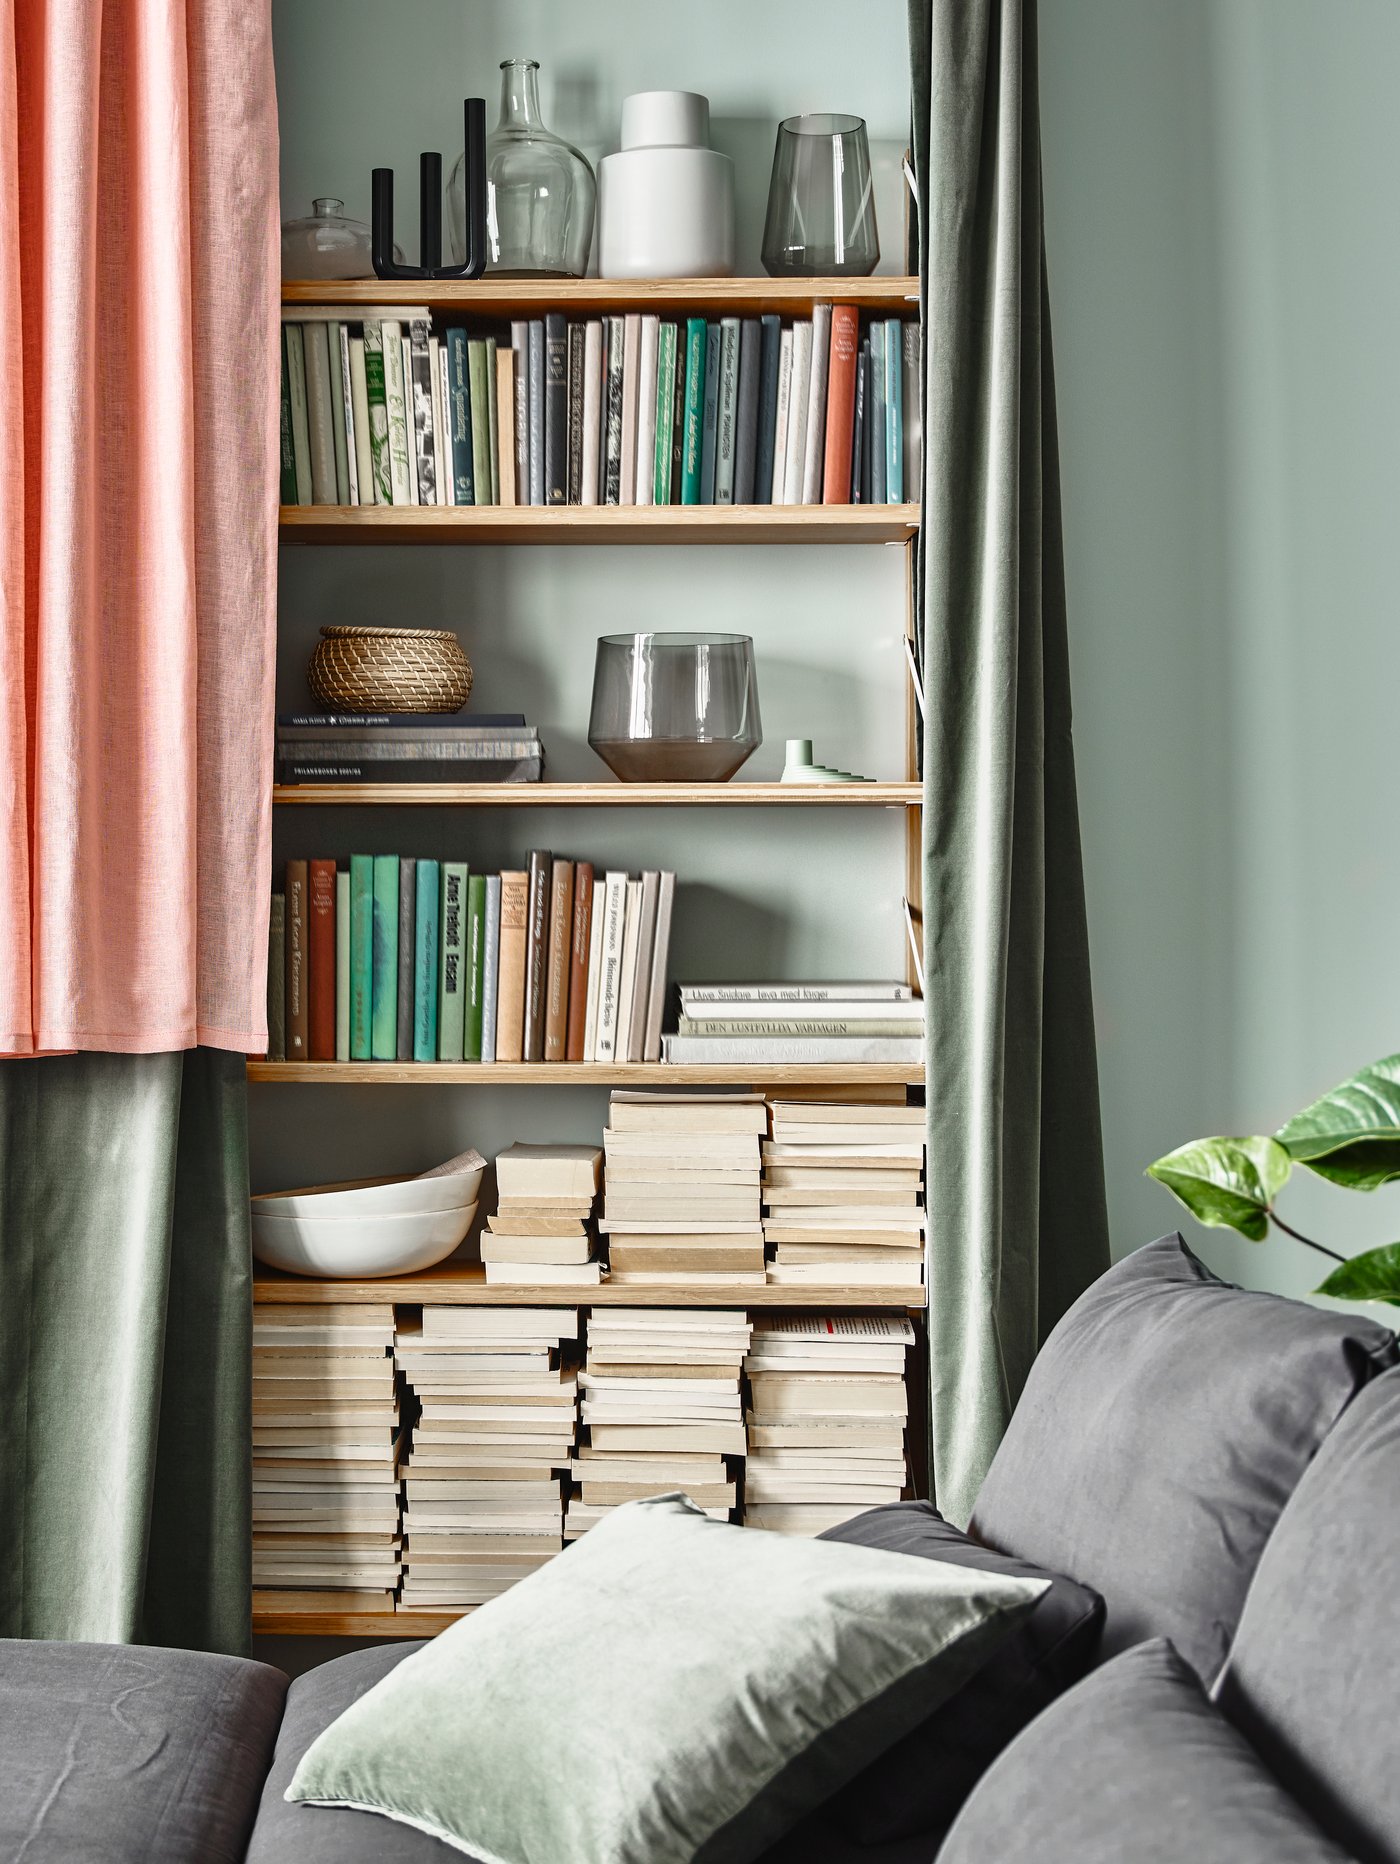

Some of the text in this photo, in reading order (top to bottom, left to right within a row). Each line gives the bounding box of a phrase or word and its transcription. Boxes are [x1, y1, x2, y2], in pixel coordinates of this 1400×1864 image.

[445, 874, 461, 994] Arne Treholt Ensam
[780, 988, 800, 1000] med
[705, 1022, 847, 1033] DEN LUSTFYLLDA VARDAGEN
